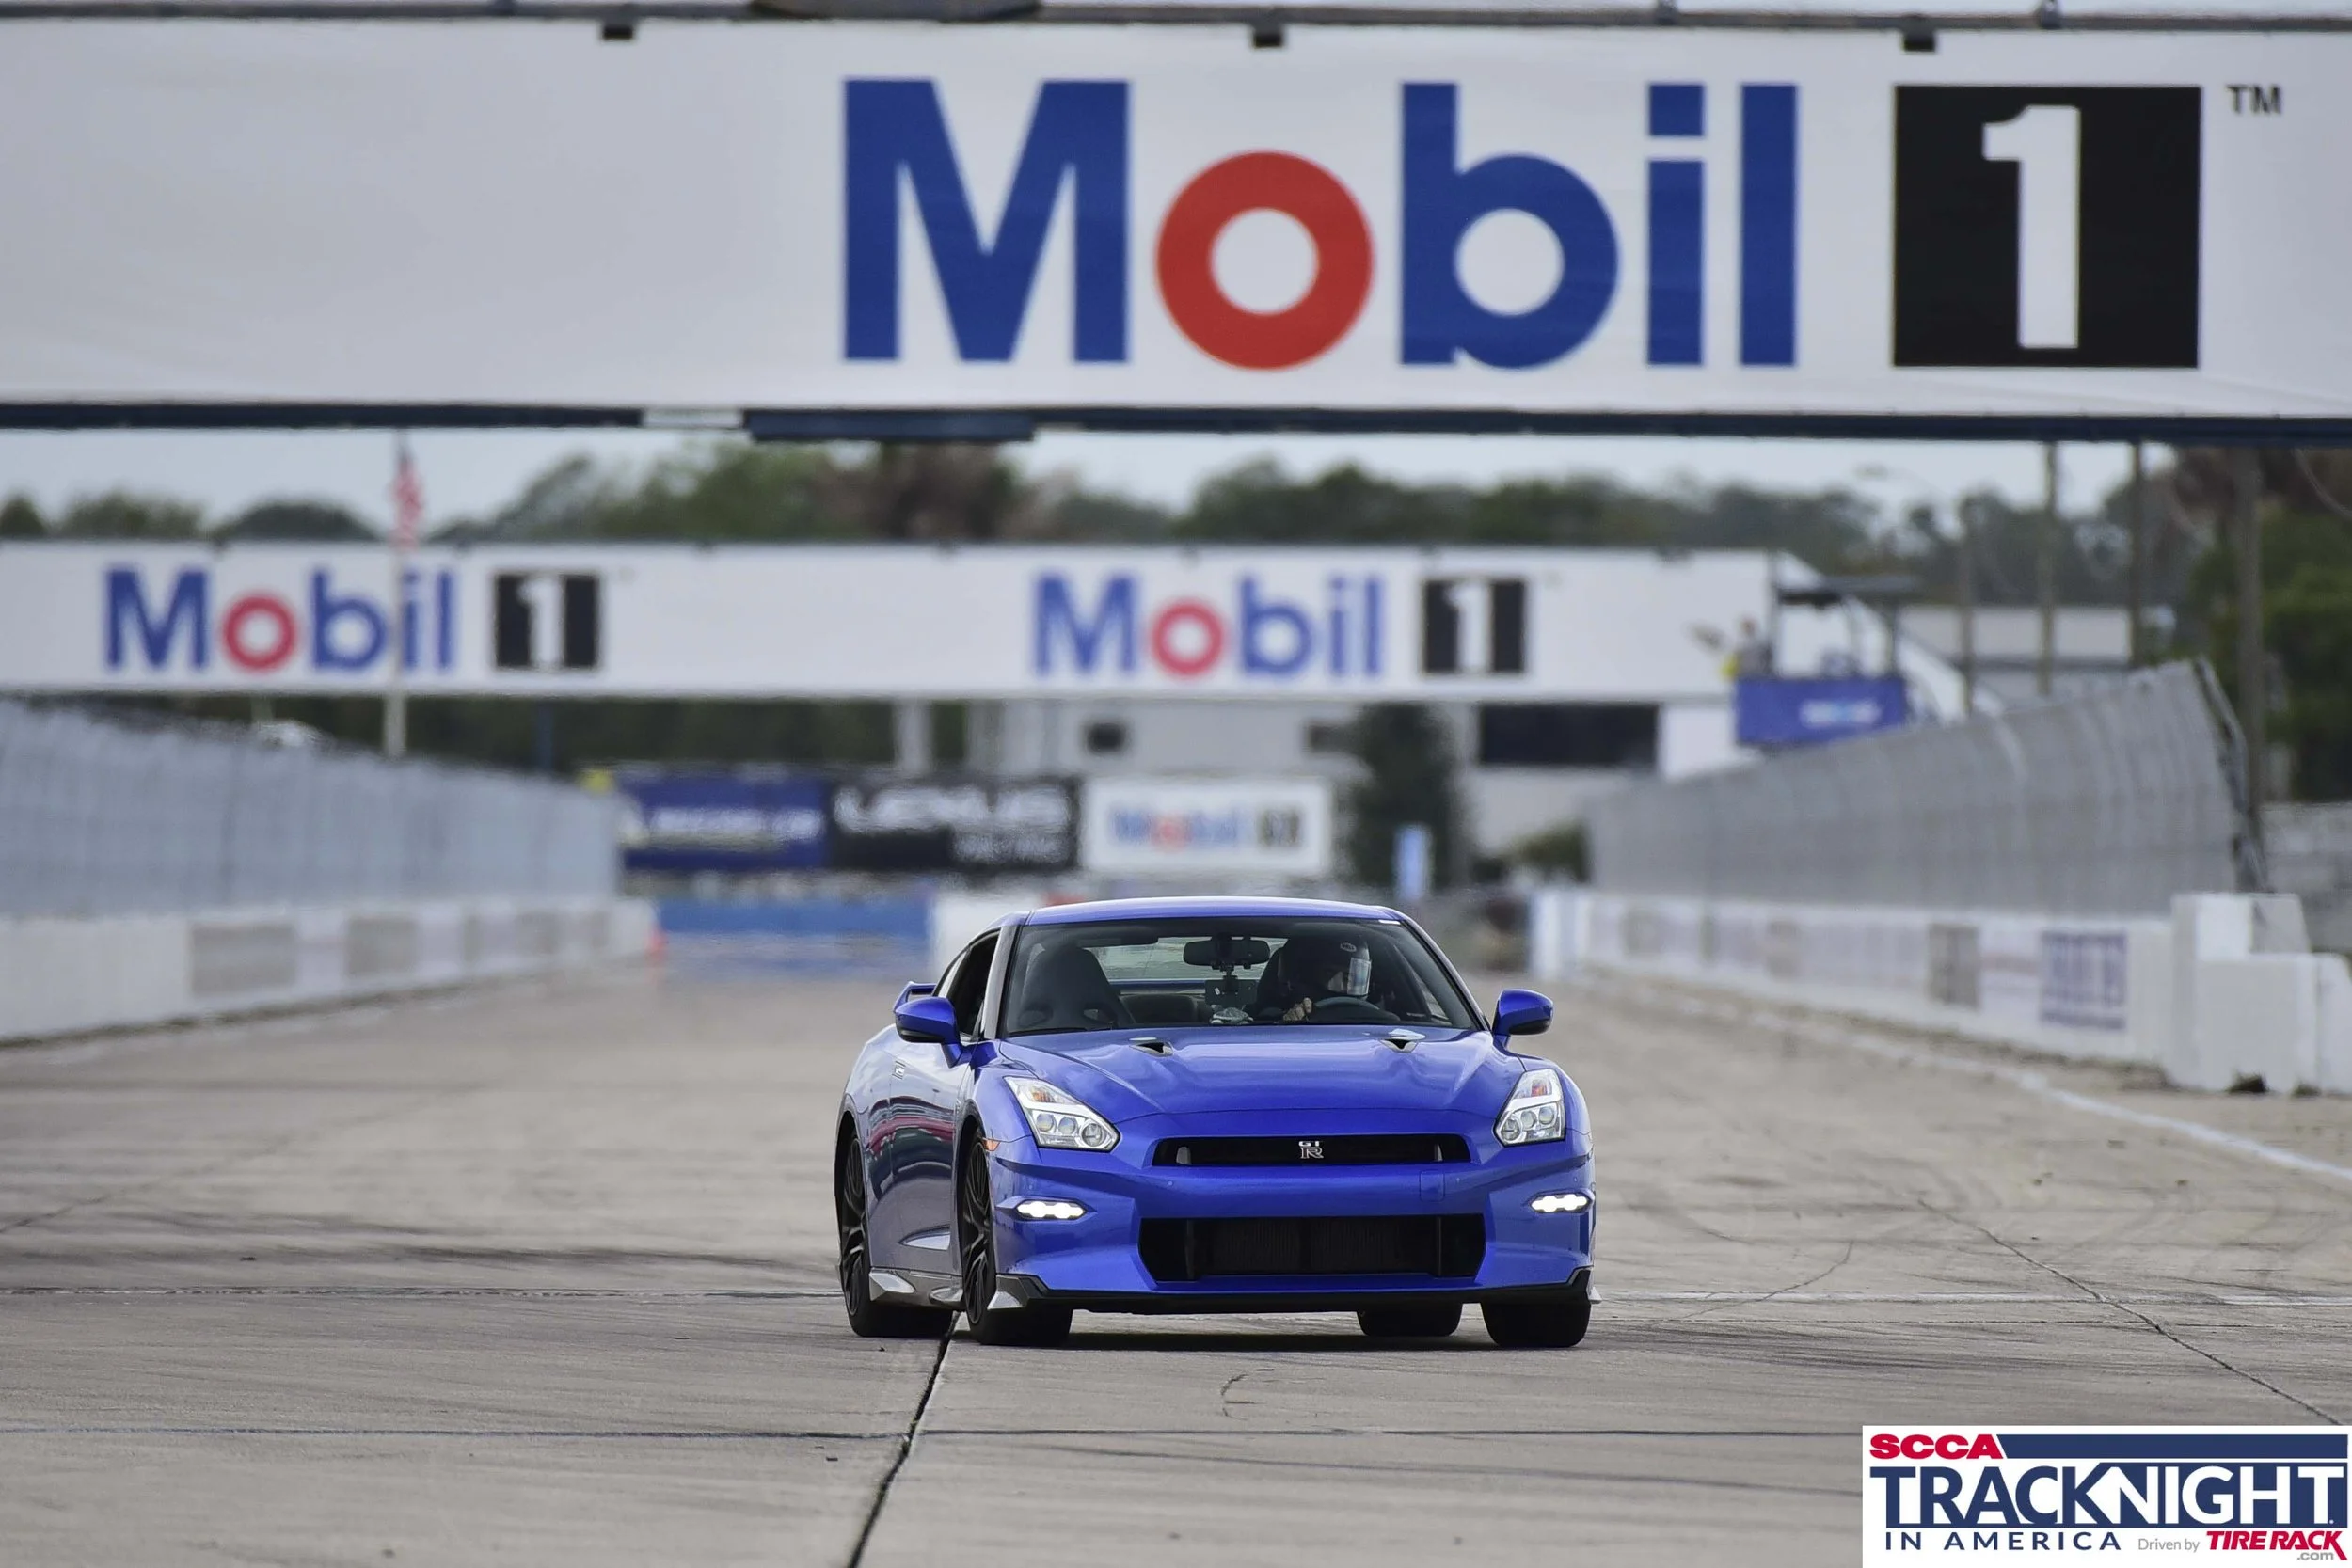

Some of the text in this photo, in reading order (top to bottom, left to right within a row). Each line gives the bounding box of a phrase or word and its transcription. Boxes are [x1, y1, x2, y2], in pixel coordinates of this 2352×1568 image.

[843, 79, 2283, 370] Mobil 1 TM
[105, 569, 453, 672] Mobil
[1035, 575, 1383, 676] Mobil
